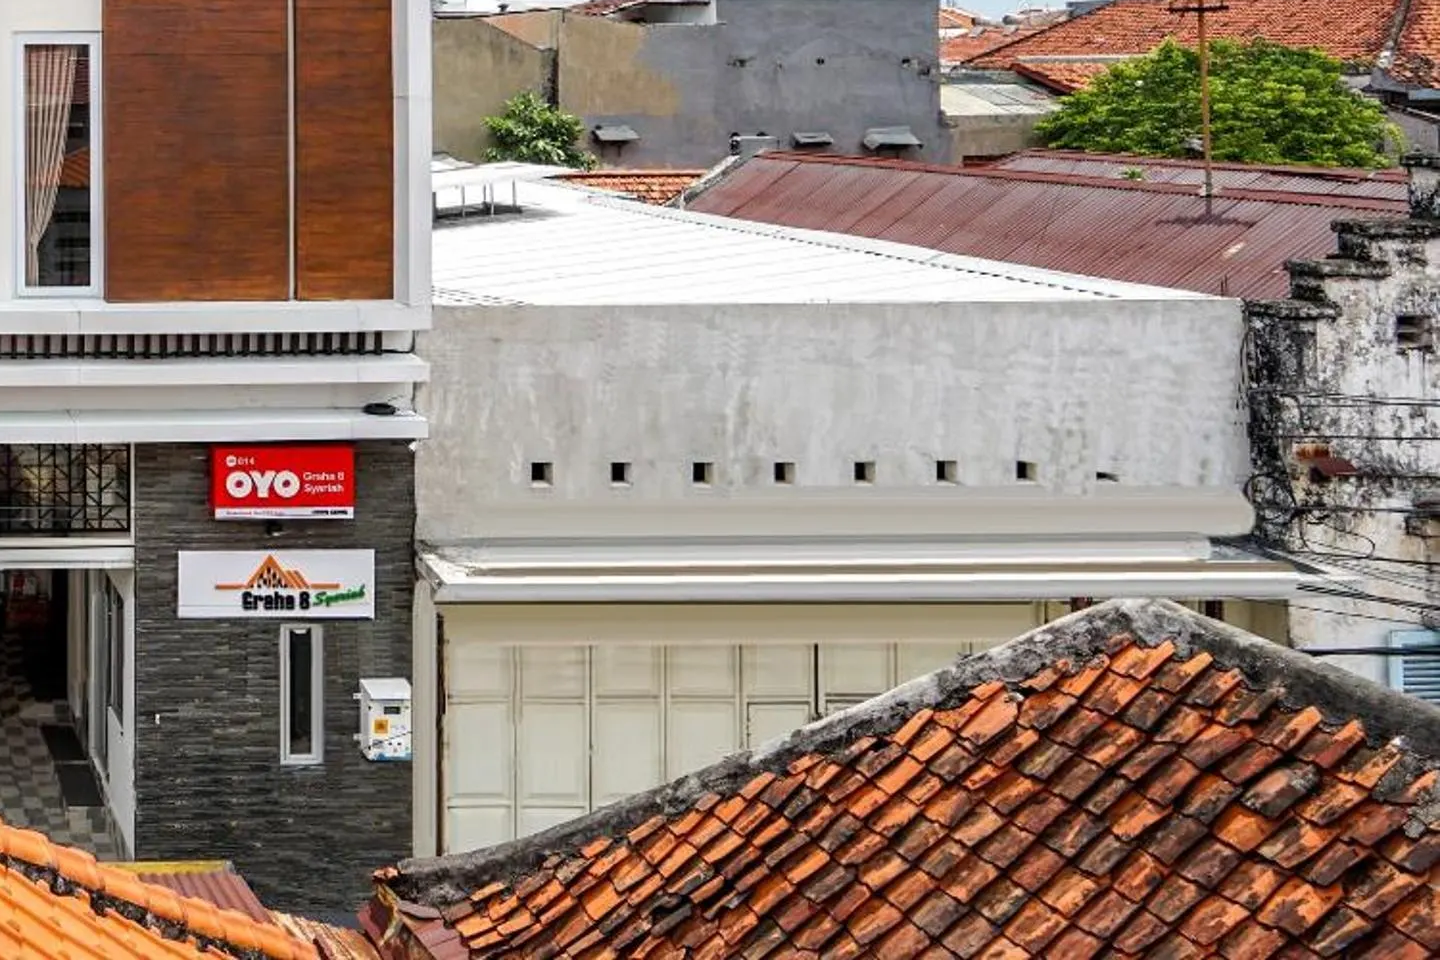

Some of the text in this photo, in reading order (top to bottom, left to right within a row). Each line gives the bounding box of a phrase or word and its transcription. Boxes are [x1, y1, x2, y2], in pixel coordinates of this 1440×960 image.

[303, 471, 336, 481] Graha
[226, 470, 300, 498] OYO
[304, 483, 345, 495] Syariah
[242, 591, 295, 610] Graha
[299, 591, 310, 610] 8
